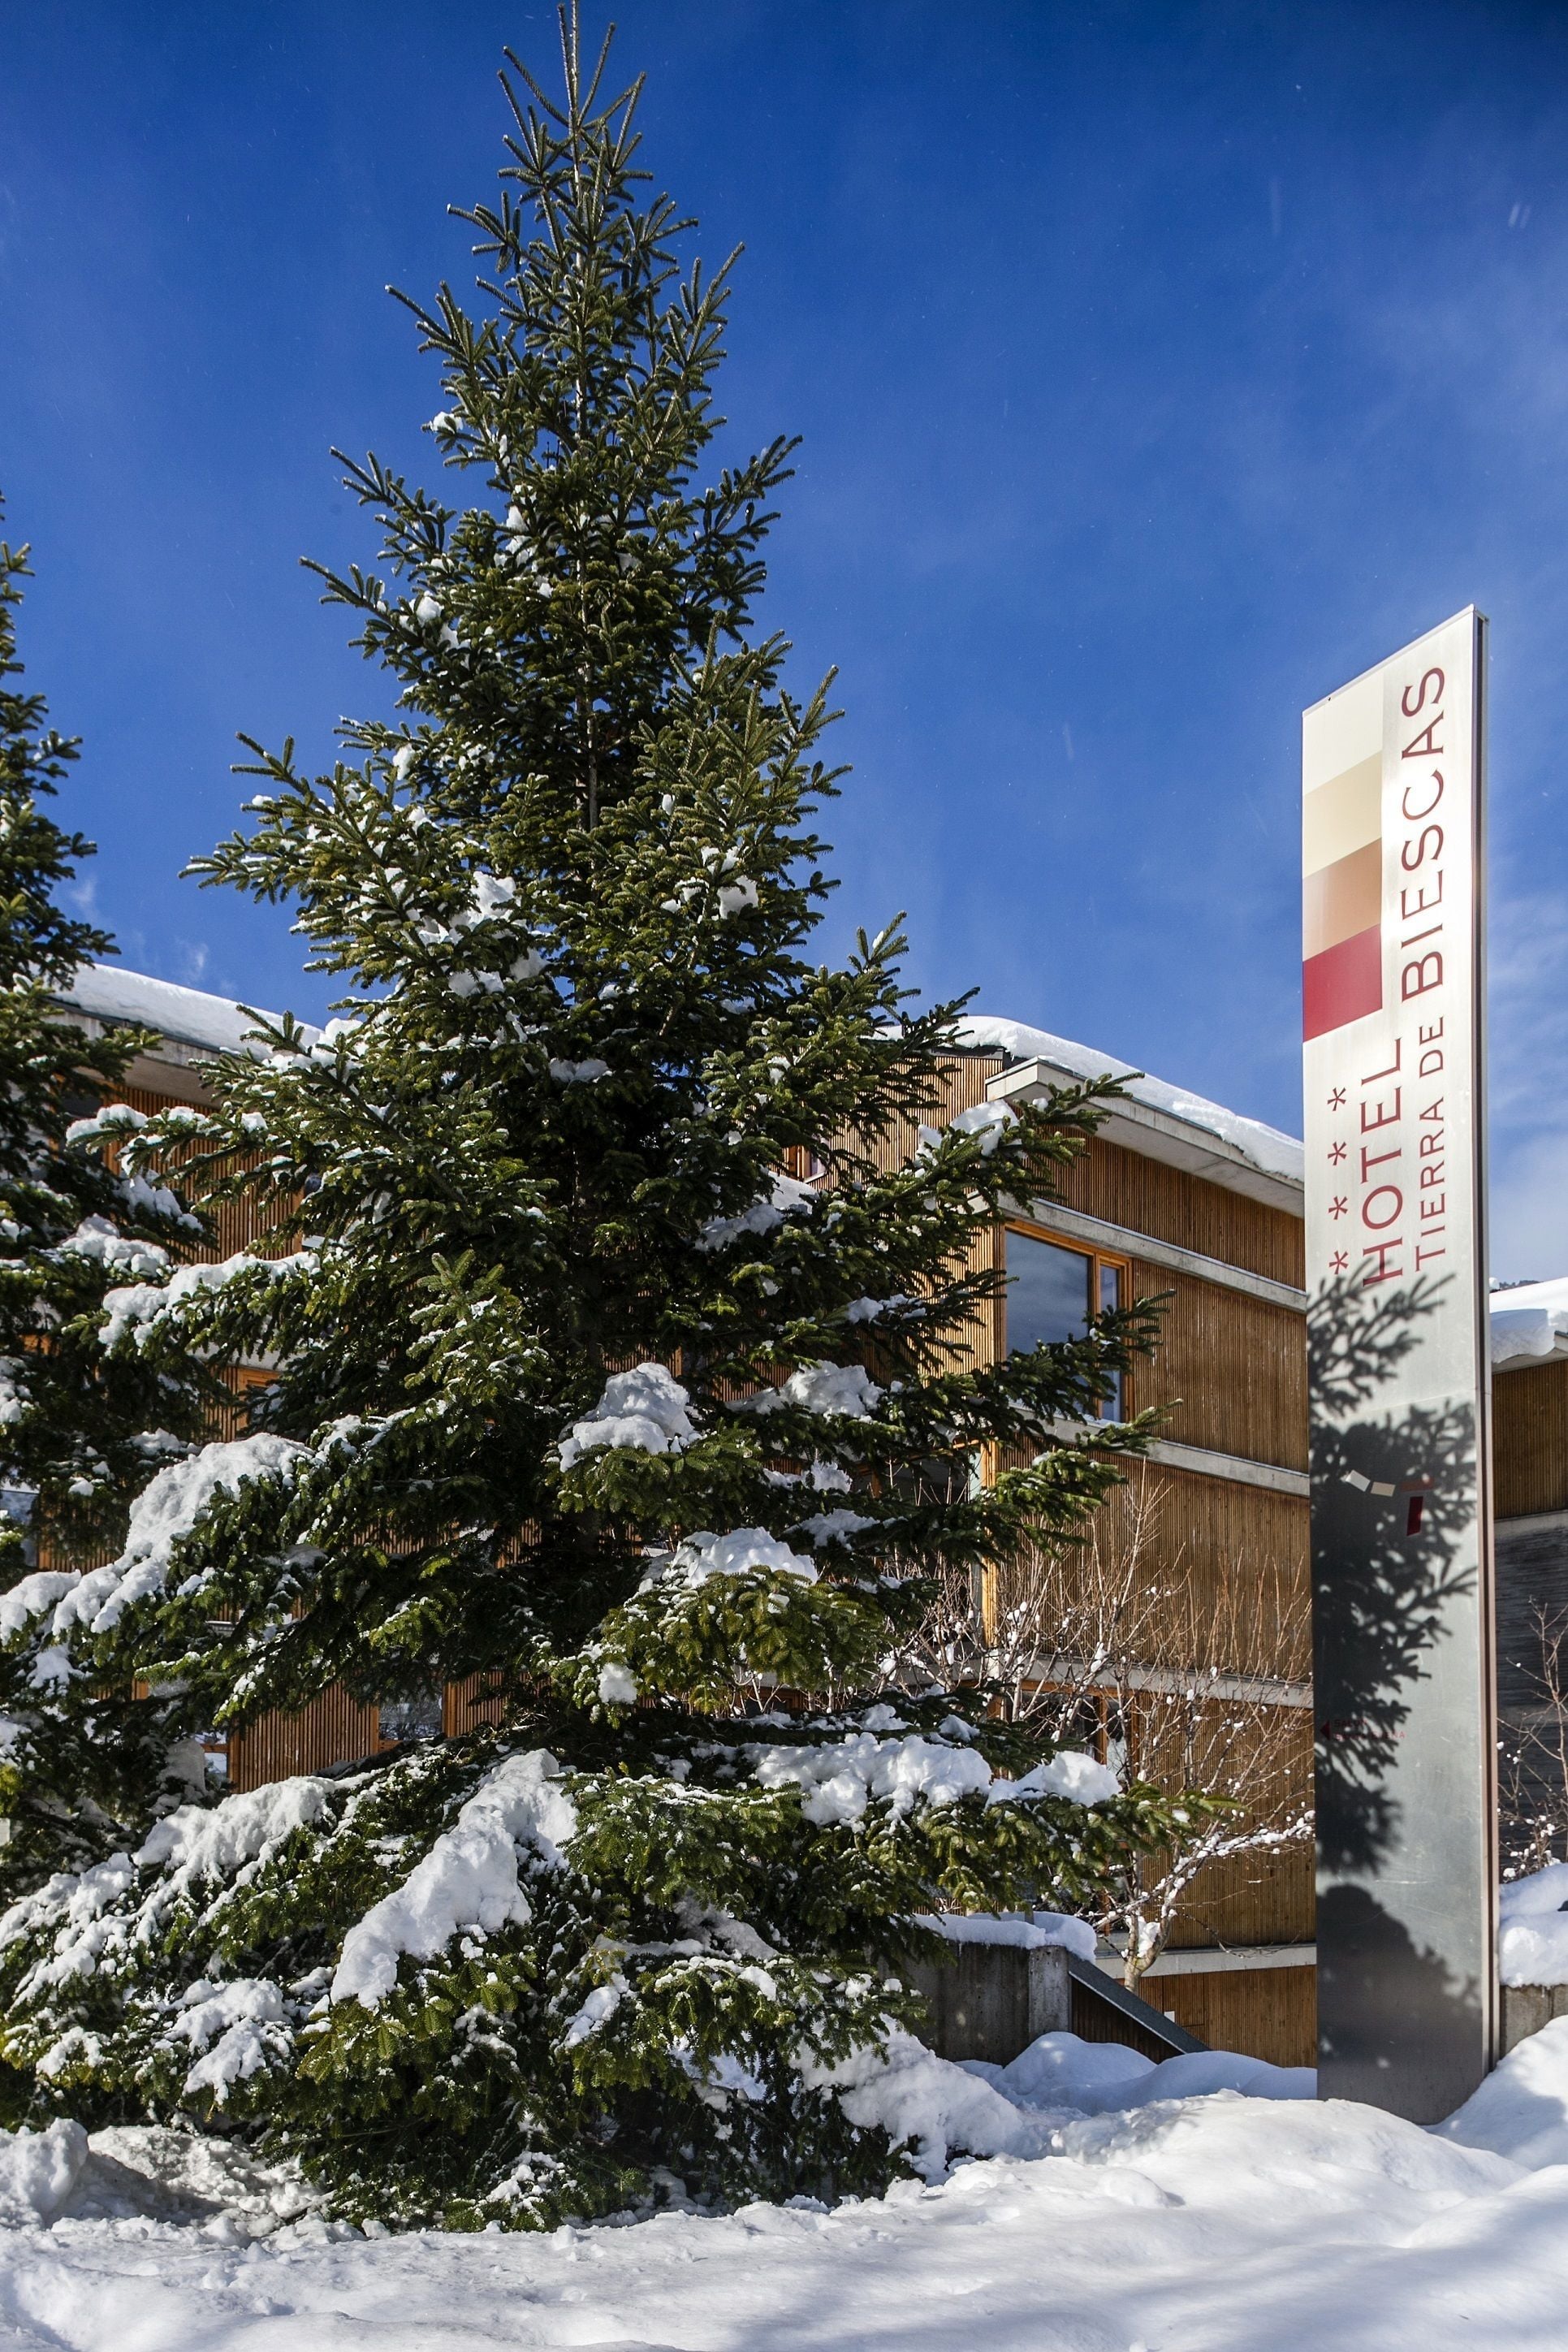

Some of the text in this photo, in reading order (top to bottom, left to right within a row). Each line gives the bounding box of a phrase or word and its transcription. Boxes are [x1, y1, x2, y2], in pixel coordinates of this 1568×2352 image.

[1360, 1037, 1403, 1287] HOTEL
[1401, 667, 1445, 1272] TIERRA DE BIESCAS
